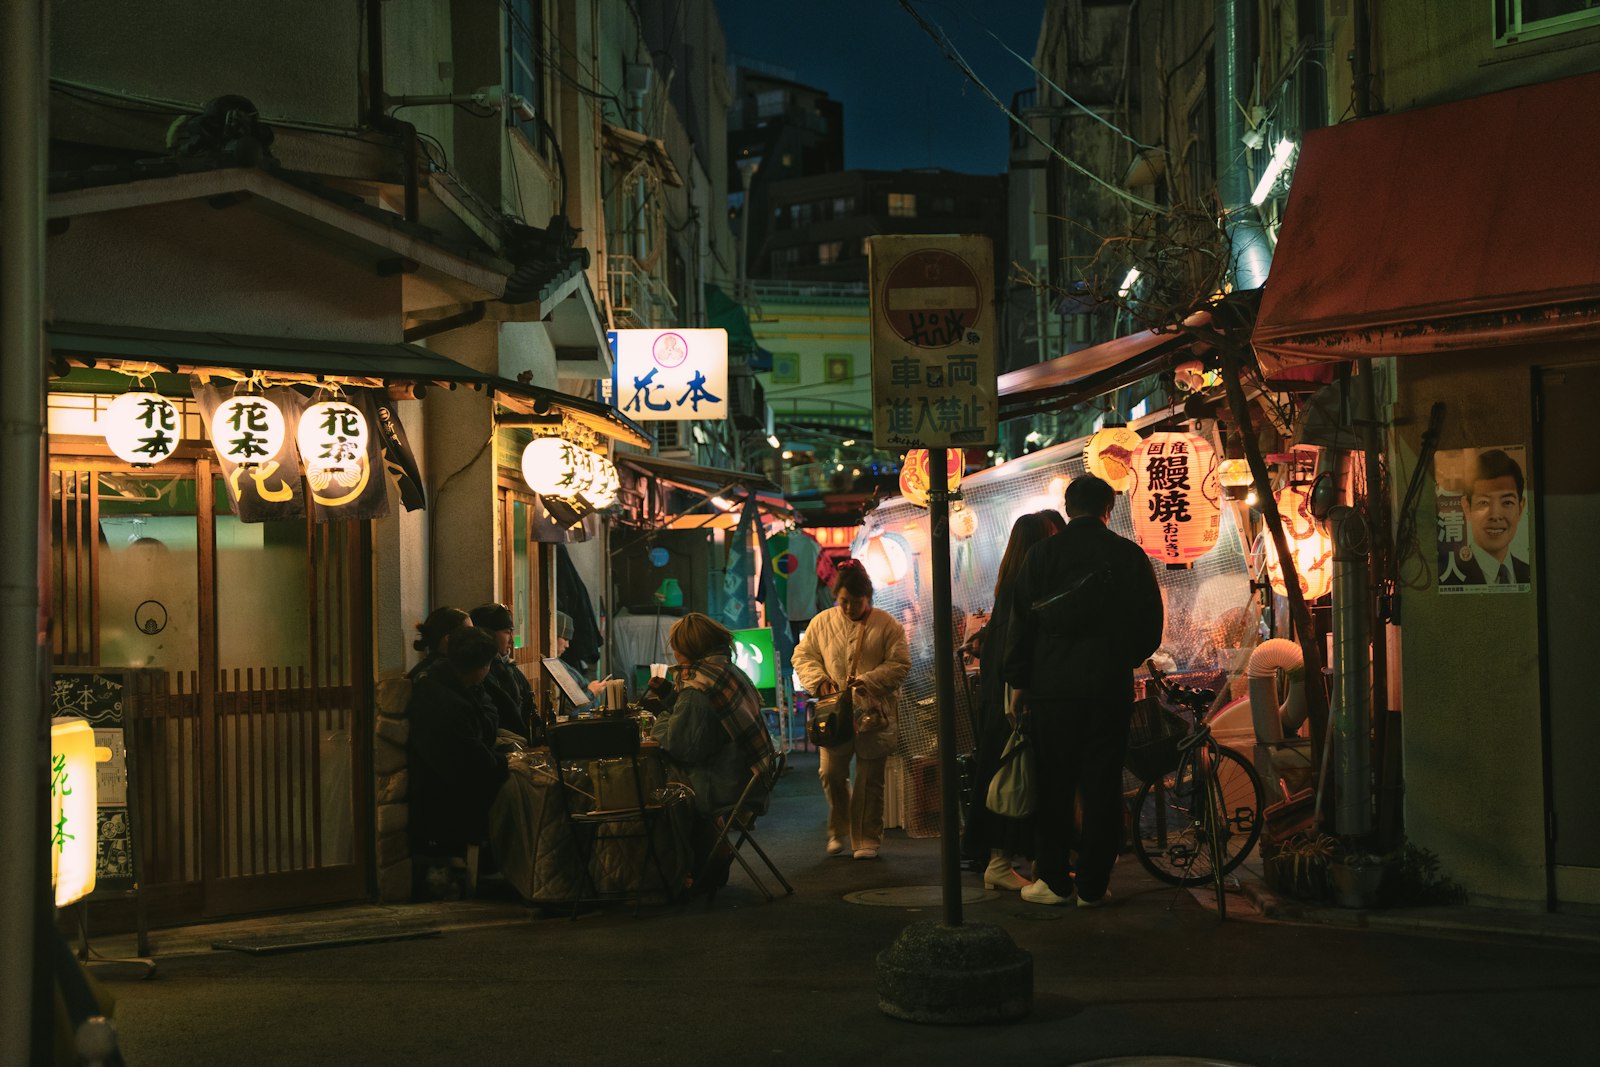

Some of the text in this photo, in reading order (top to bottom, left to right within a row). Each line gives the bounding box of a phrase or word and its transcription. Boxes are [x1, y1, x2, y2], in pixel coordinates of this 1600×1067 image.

[623, 367, 722, 412] 花本
[891, 354, 978, 388] 車両
[132, 398, 177, 458] 花本
[226, 402, 270, 458] 花本
[319, 407, 361, 463] 花本
[887, 396, 985, 433] 進入禁止
[1147, 442, 1189, 455] 国産
[1146, 456, 1192, 522] 鰻焼
[51, 753, 75, 853] 花本
